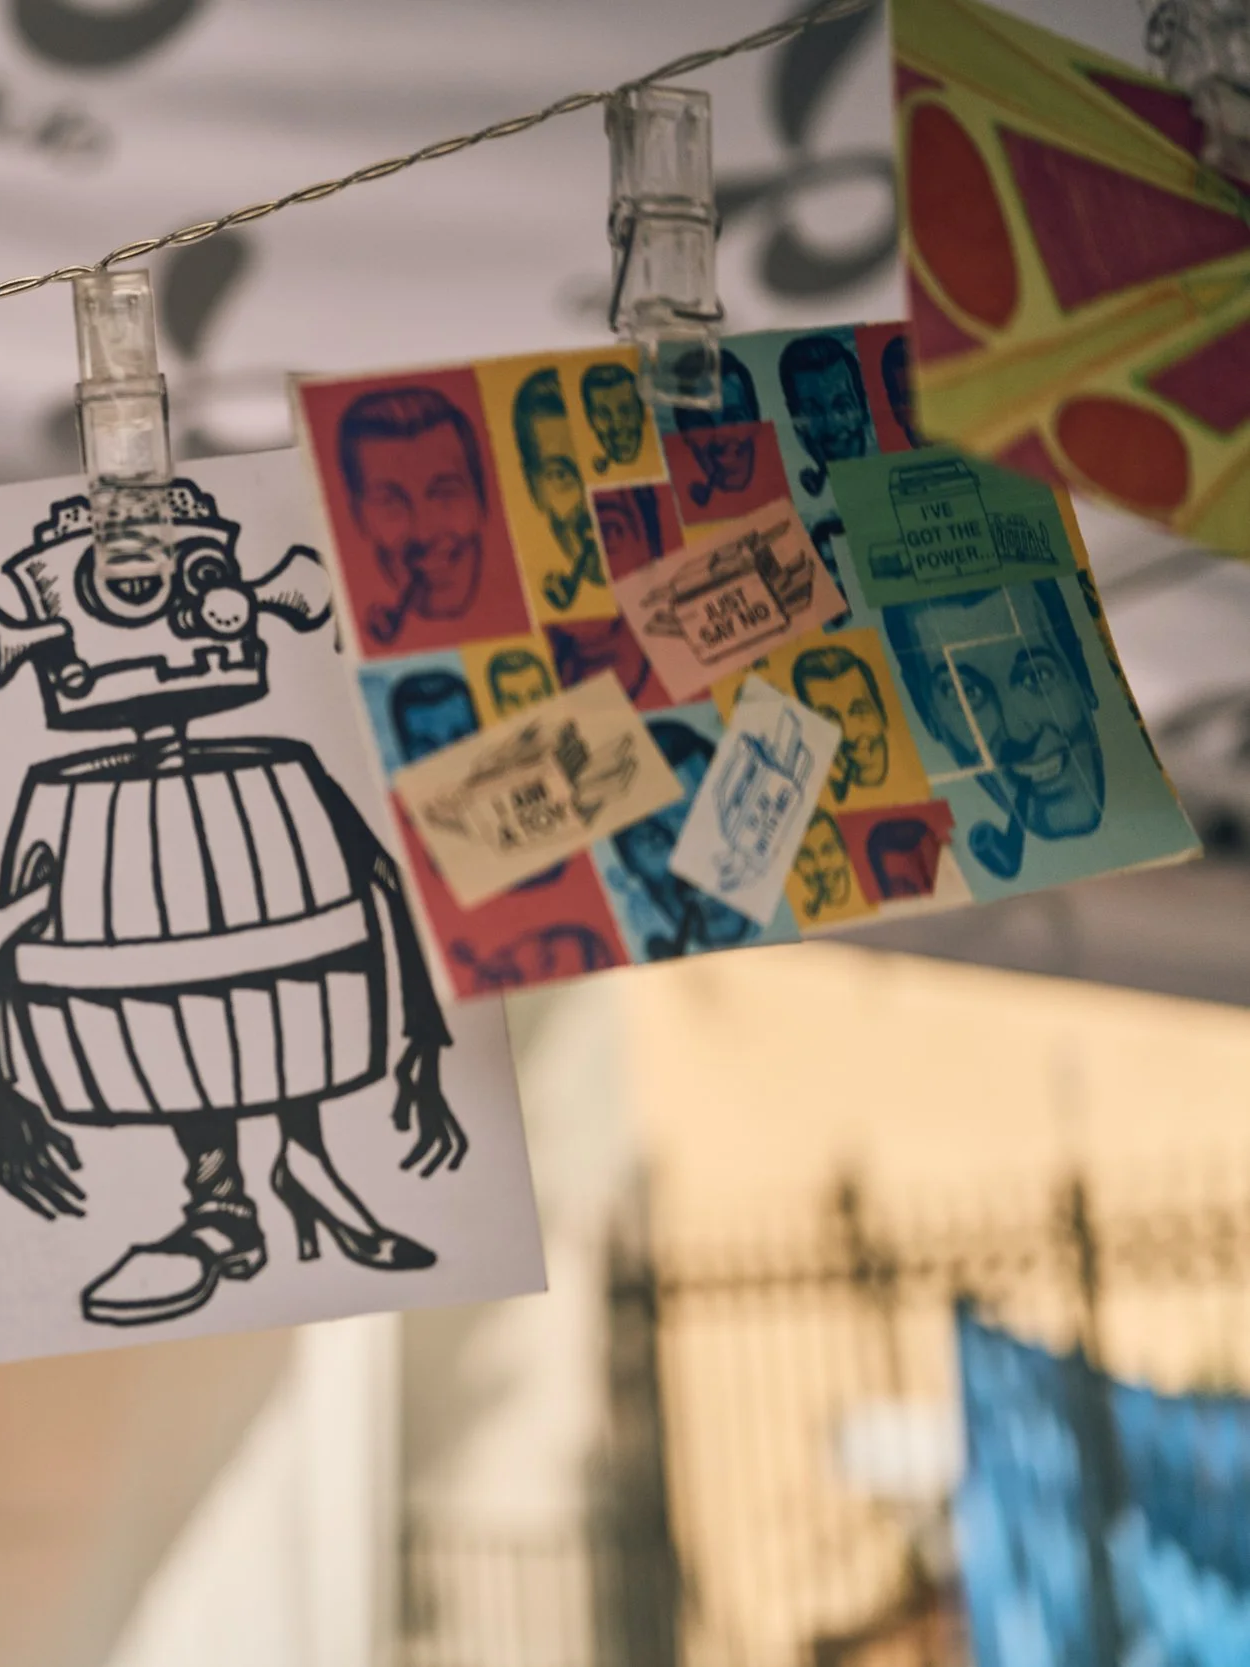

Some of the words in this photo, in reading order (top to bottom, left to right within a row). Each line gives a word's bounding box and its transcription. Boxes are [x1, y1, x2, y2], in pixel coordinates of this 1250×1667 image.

[920, 501, 953, 521] I'VE
[906, 526, 942, 548] GOT
[946, 520, 982, 541] THE
[915, 545, 996, 571] POWER...
[705, 586, 748, 621] JUST
[699, 617, 737, 648] SAY
[738, 602, 771, 630] NO
